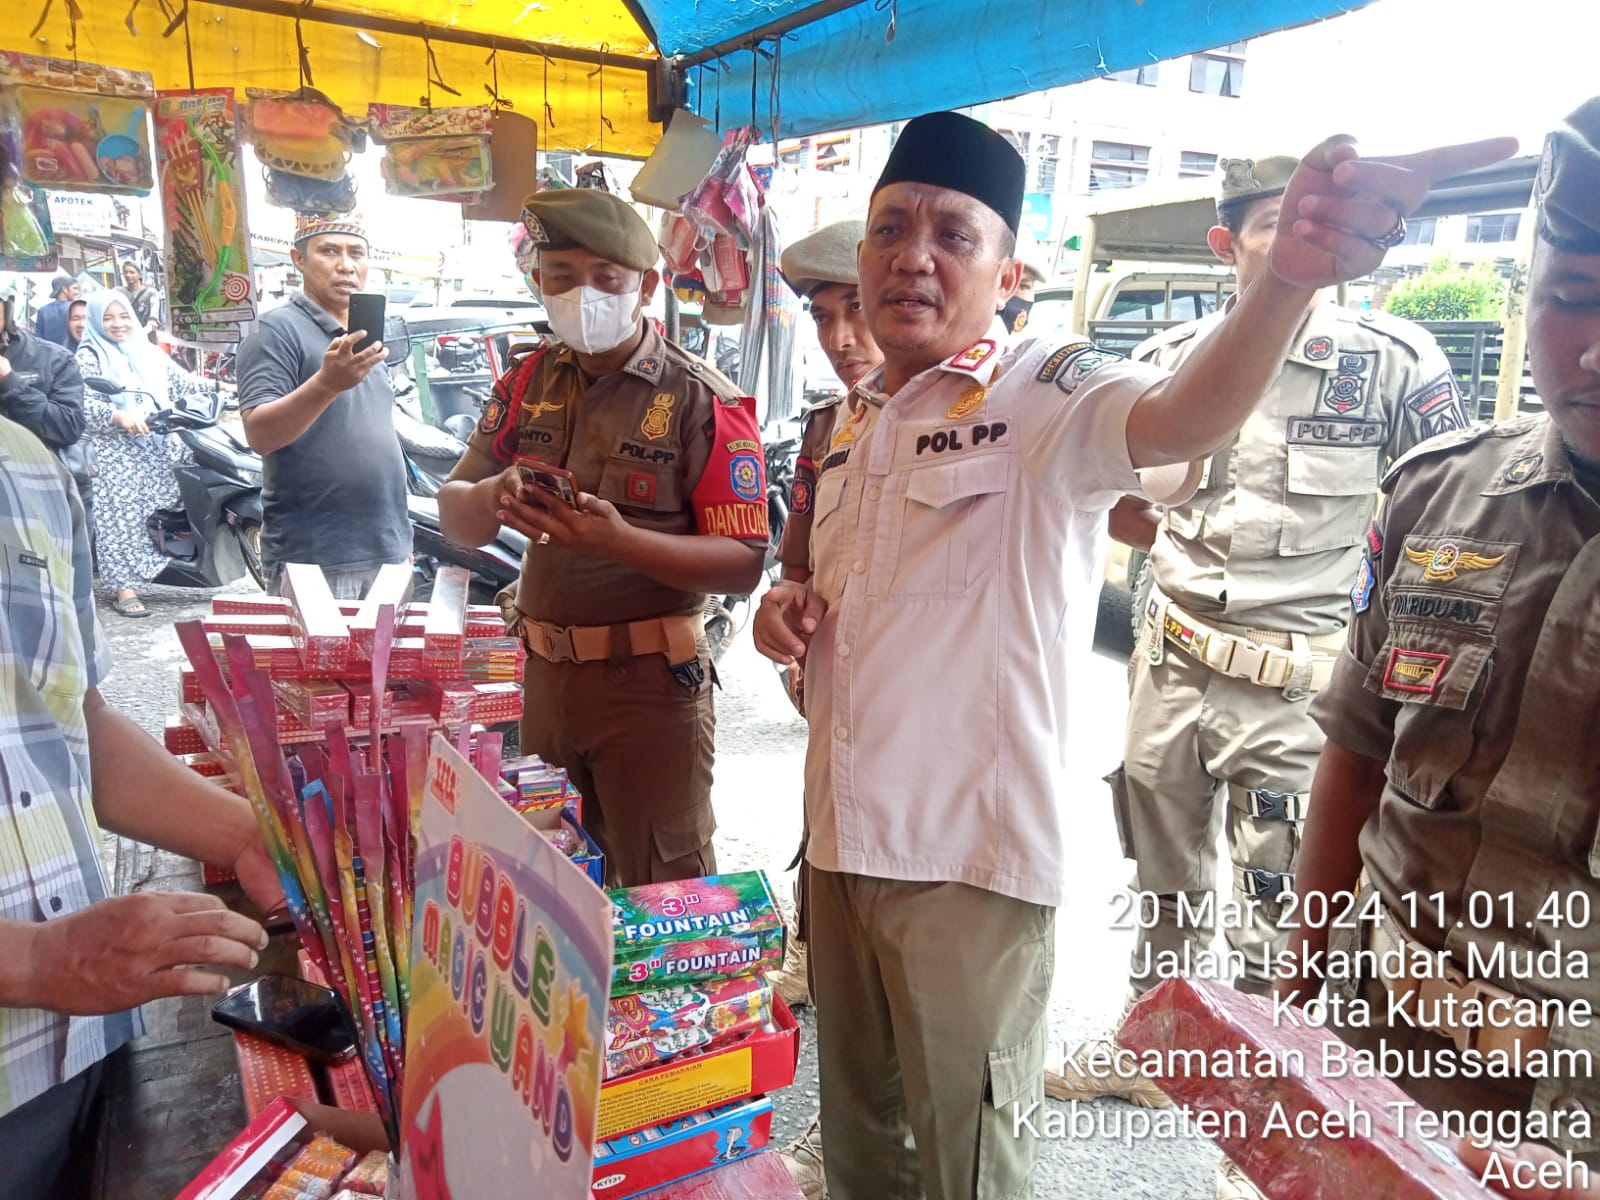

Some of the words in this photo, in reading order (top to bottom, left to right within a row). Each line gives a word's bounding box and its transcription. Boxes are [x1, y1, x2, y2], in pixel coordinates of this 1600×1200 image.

[55, 196, 93, 205] APOTEK
[250, 232, 294, 247] KABUPAT
[519, 431, 552, 443] ANTO
[917, 430, 962, 454] POL
[972, 422, 1007, 446] PP
[1298, 422, 1377, 441] POL-PP
[619, 442, 675, 465] POL-PP
[661, 894, 700, 917] 3"
[447, 834, 555, 1027] BUBBLE
[625, 907, 750, 940] FOUNTAIN
[423, 900, 487, 1035] MAGIC
[629, 960, 662, 982] 3"
[666, 946, 762, 975] FOUNTAIN
[490, 973, 573, 1163] WAND
